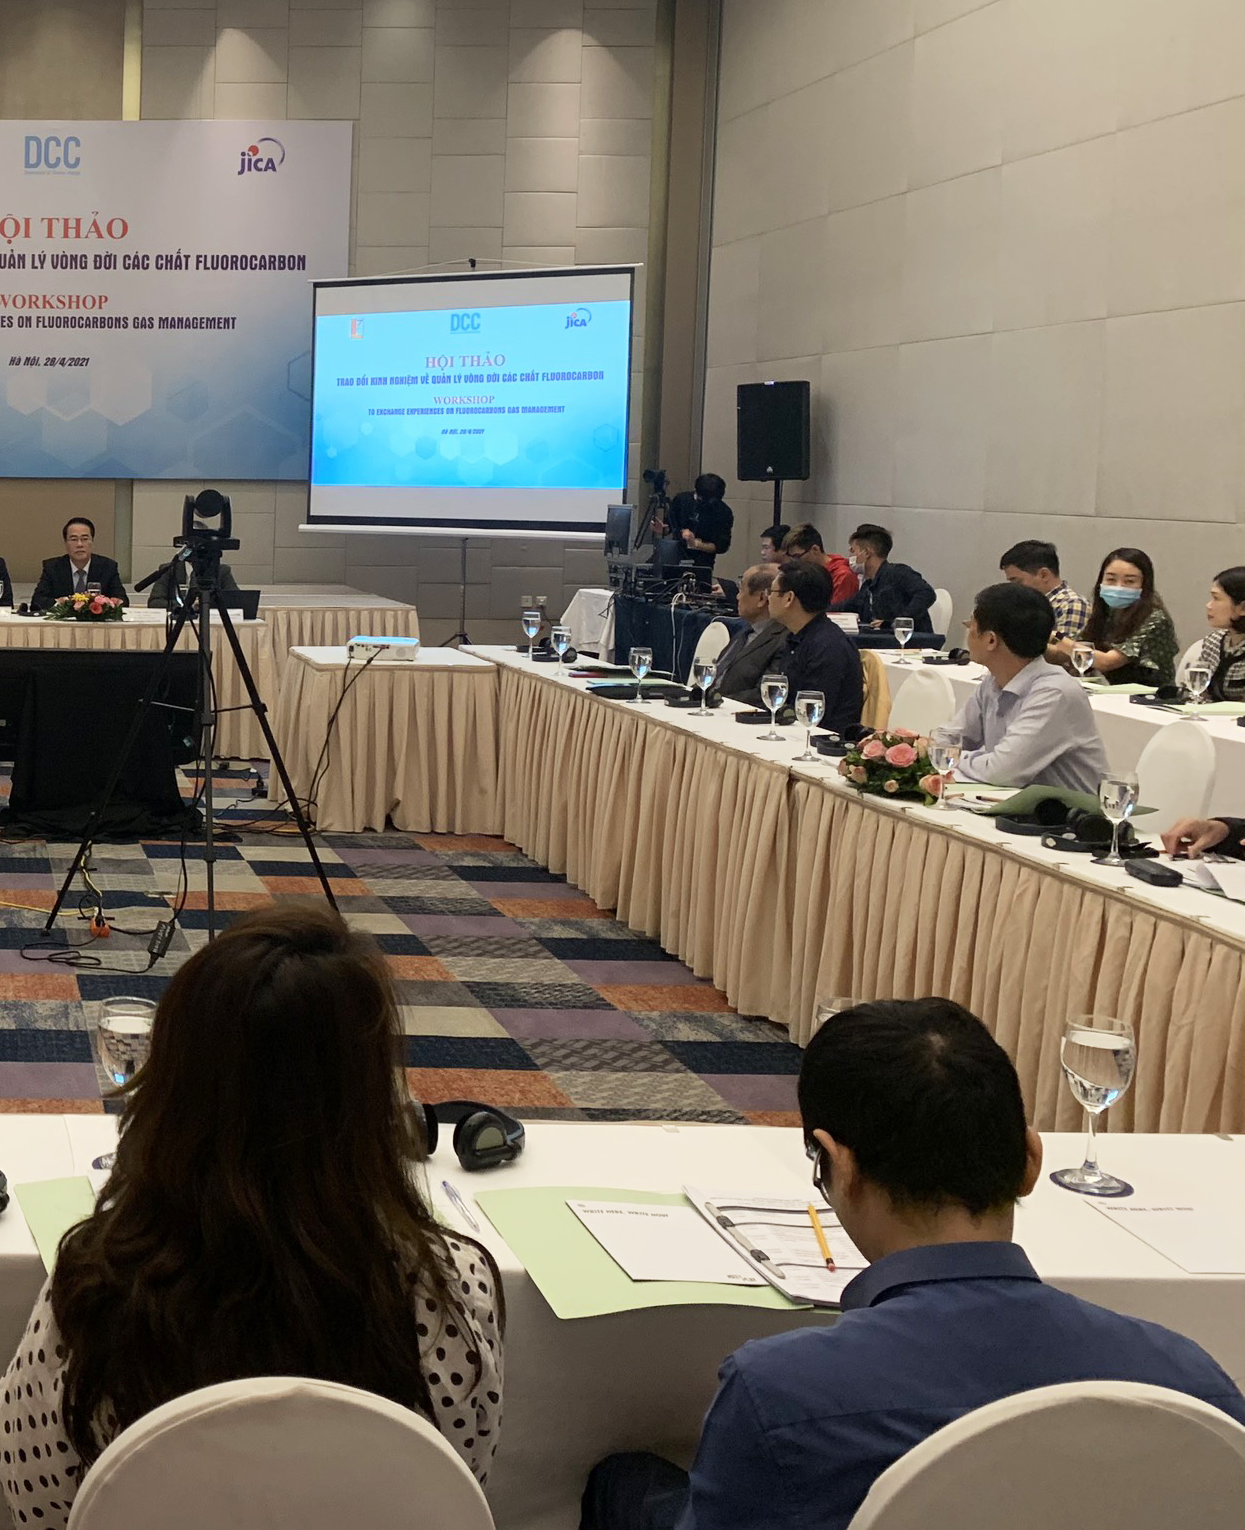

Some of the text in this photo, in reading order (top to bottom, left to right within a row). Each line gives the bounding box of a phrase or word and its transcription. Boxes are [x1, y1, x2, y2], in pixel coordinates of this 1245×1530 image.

[24, 136, 81, 169] DCC
[40, 211, 129, 240] THẢO
[31, 251, 46, 270] LÝ
[50, 251, 88, 271] VÒNG
[93, 251, 117, 271] ĐỜI
[122, 251, 150, 271] CÁC
[155, 248, 191, 271] CHẤT
[195, 254, 307, 271] FLUOROCARBON
[17, 315, 32, 329] ON
[36, 315, 129, 329] FLUOROCARBONS
[132, 316, 155, 329] GAS
[158, 316, 237, 330] MANAGEMENT
[450, 312, 481, 331] DCC
[8, 356, 22, 367] Hà
[425, 351, 506, 371] HỘI THẢO
[336, 377, 354, 387] TRAO
[370, 377, 387, 386] KINH
[502, 372, 517, 383] CÁC
[541, 370, 604, 381] FLUOROCARBON
[433, 395, 495, 405] WORKSHOP
